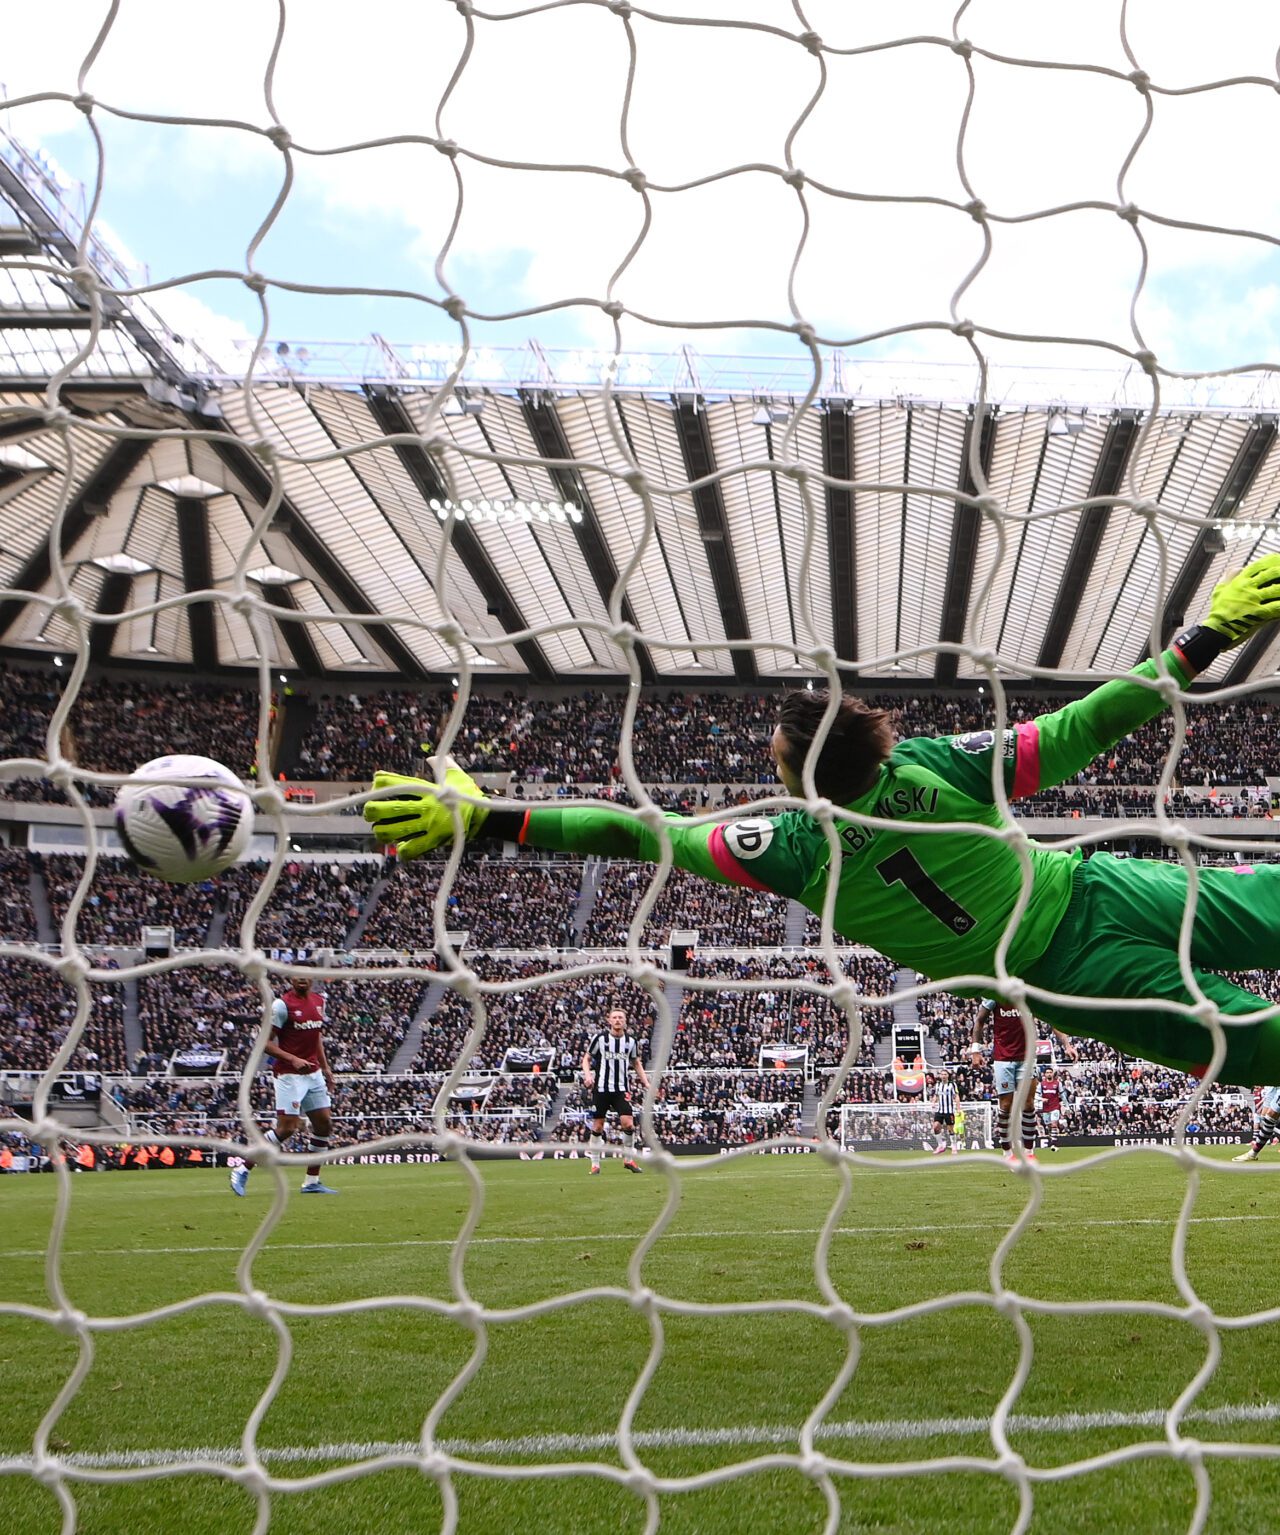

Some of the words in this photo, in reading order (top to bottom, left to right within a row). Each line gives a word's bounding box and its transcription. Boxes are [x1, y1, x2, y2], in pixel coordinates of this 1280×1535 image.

[825, 786, 939, 870] BINSKI
[735, 823, 762, 852] JD
[875, 845, 978, 938] 1
[294, 1019, 323, 1031] betwa
[956, 1138, 1050, 1150] CASE
[1114, 1138, 1157, 1148] BETTER
[1204, 1136, 1242, 1146] STOPS
[720, 1146, 765, 1156] BETR
[771, 1146, 811, 1155] NEVER
[325, 1155, 355, 1166] TER
[360, 1154, 401, 1164] NEVER
